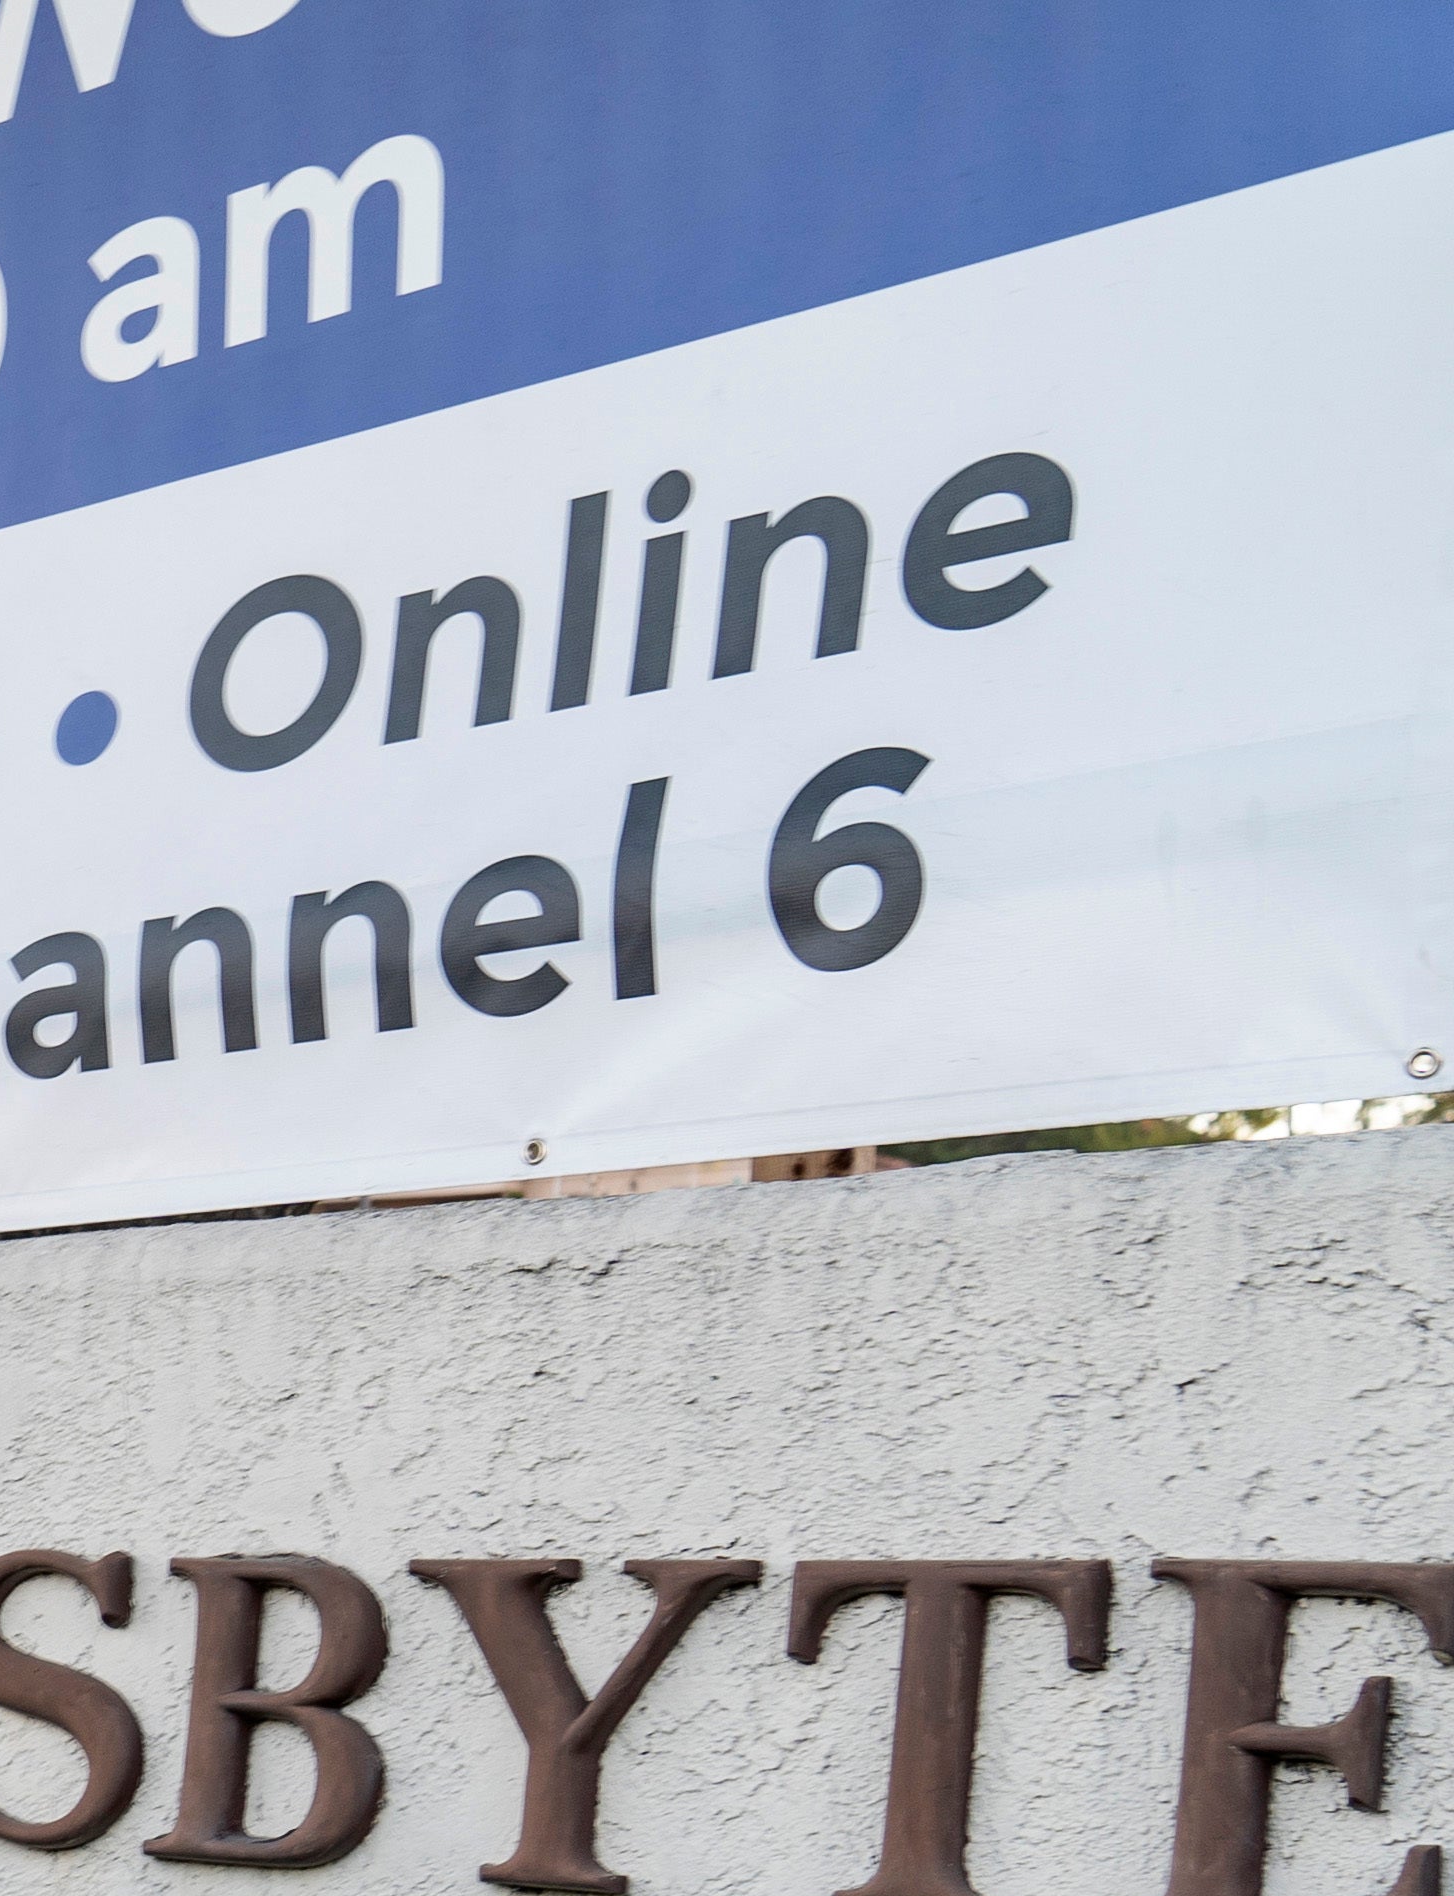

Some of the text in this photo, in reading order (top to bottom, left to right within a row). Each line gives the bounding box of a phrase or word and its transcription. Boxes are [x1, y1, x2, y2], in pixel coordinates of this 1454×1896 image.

[80, 132, 445, 385] am
[188, 451, 1075, 773] Online
[767, 746, 934, 972] 6
